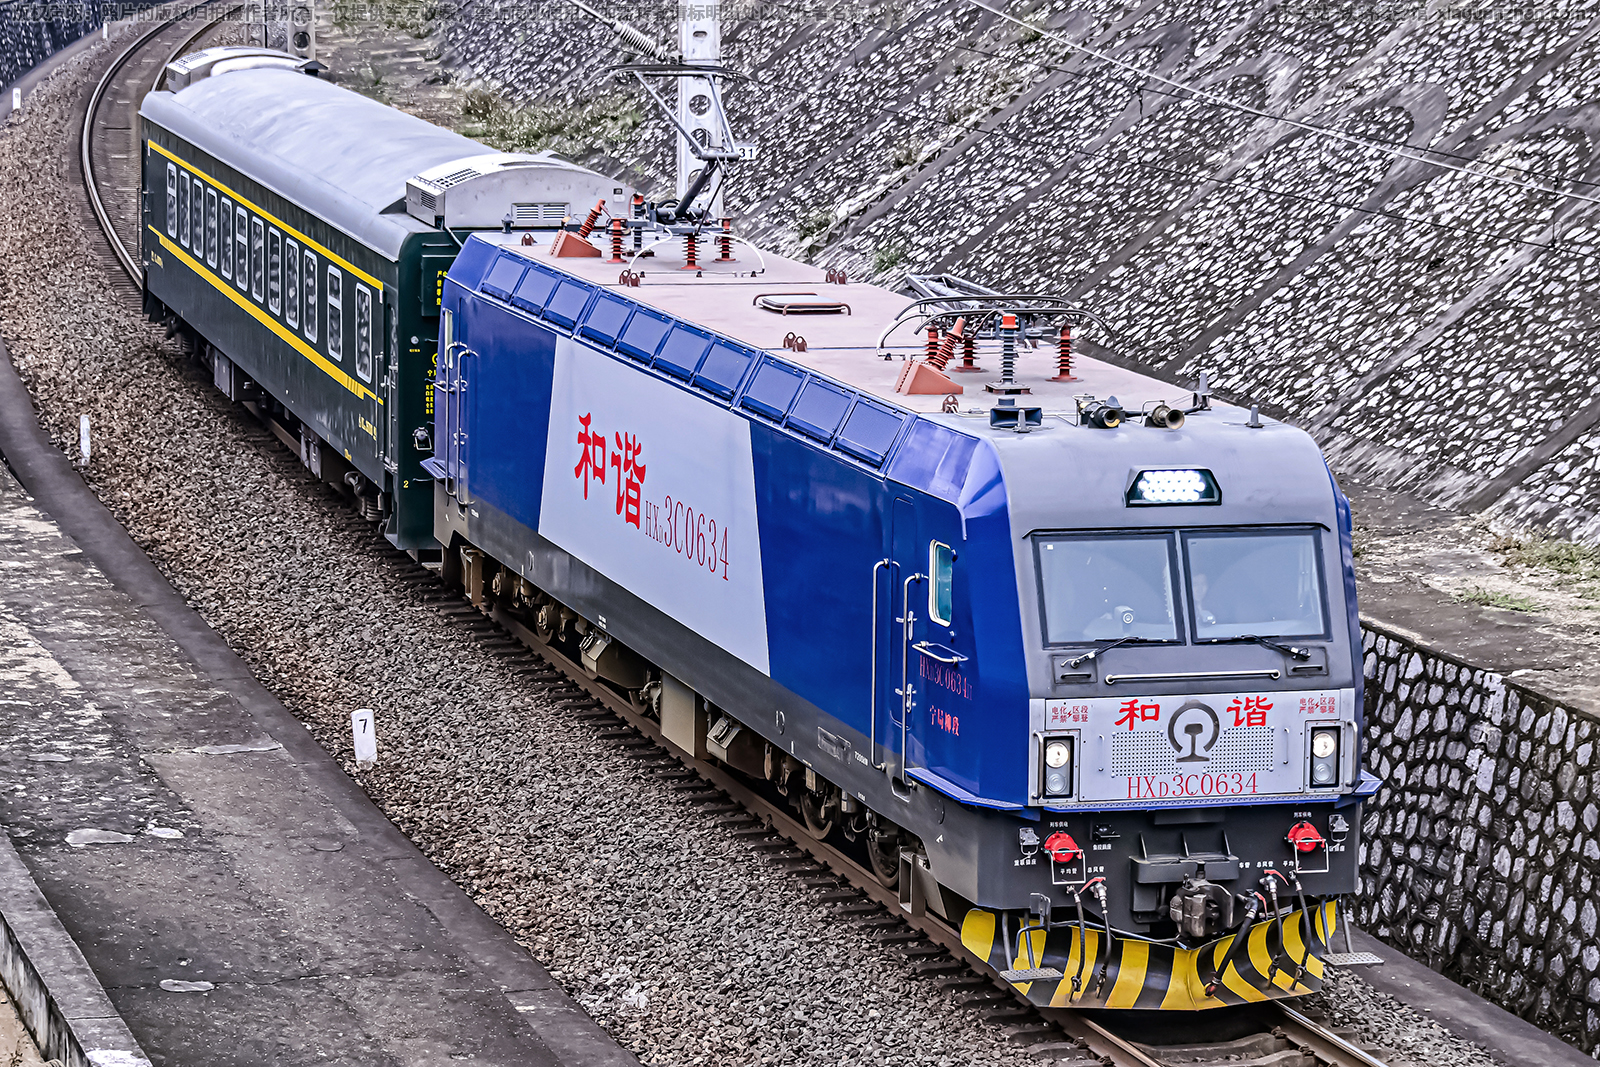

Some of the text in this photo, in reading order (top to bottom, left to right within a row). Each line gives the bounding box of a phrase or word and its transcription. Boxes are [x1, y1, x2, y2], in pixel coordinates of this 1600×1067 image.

[739, 148, 753, 159] 31
[403, 479, 409, 489] 2
[574, 412, 730, 581] 和谐 HXD3C0634
[1114, 695, 1274, 731] 和 谐
[358, 718, 368, 734] 7
[1127, 771, 1259, 799] HXD3C0634
